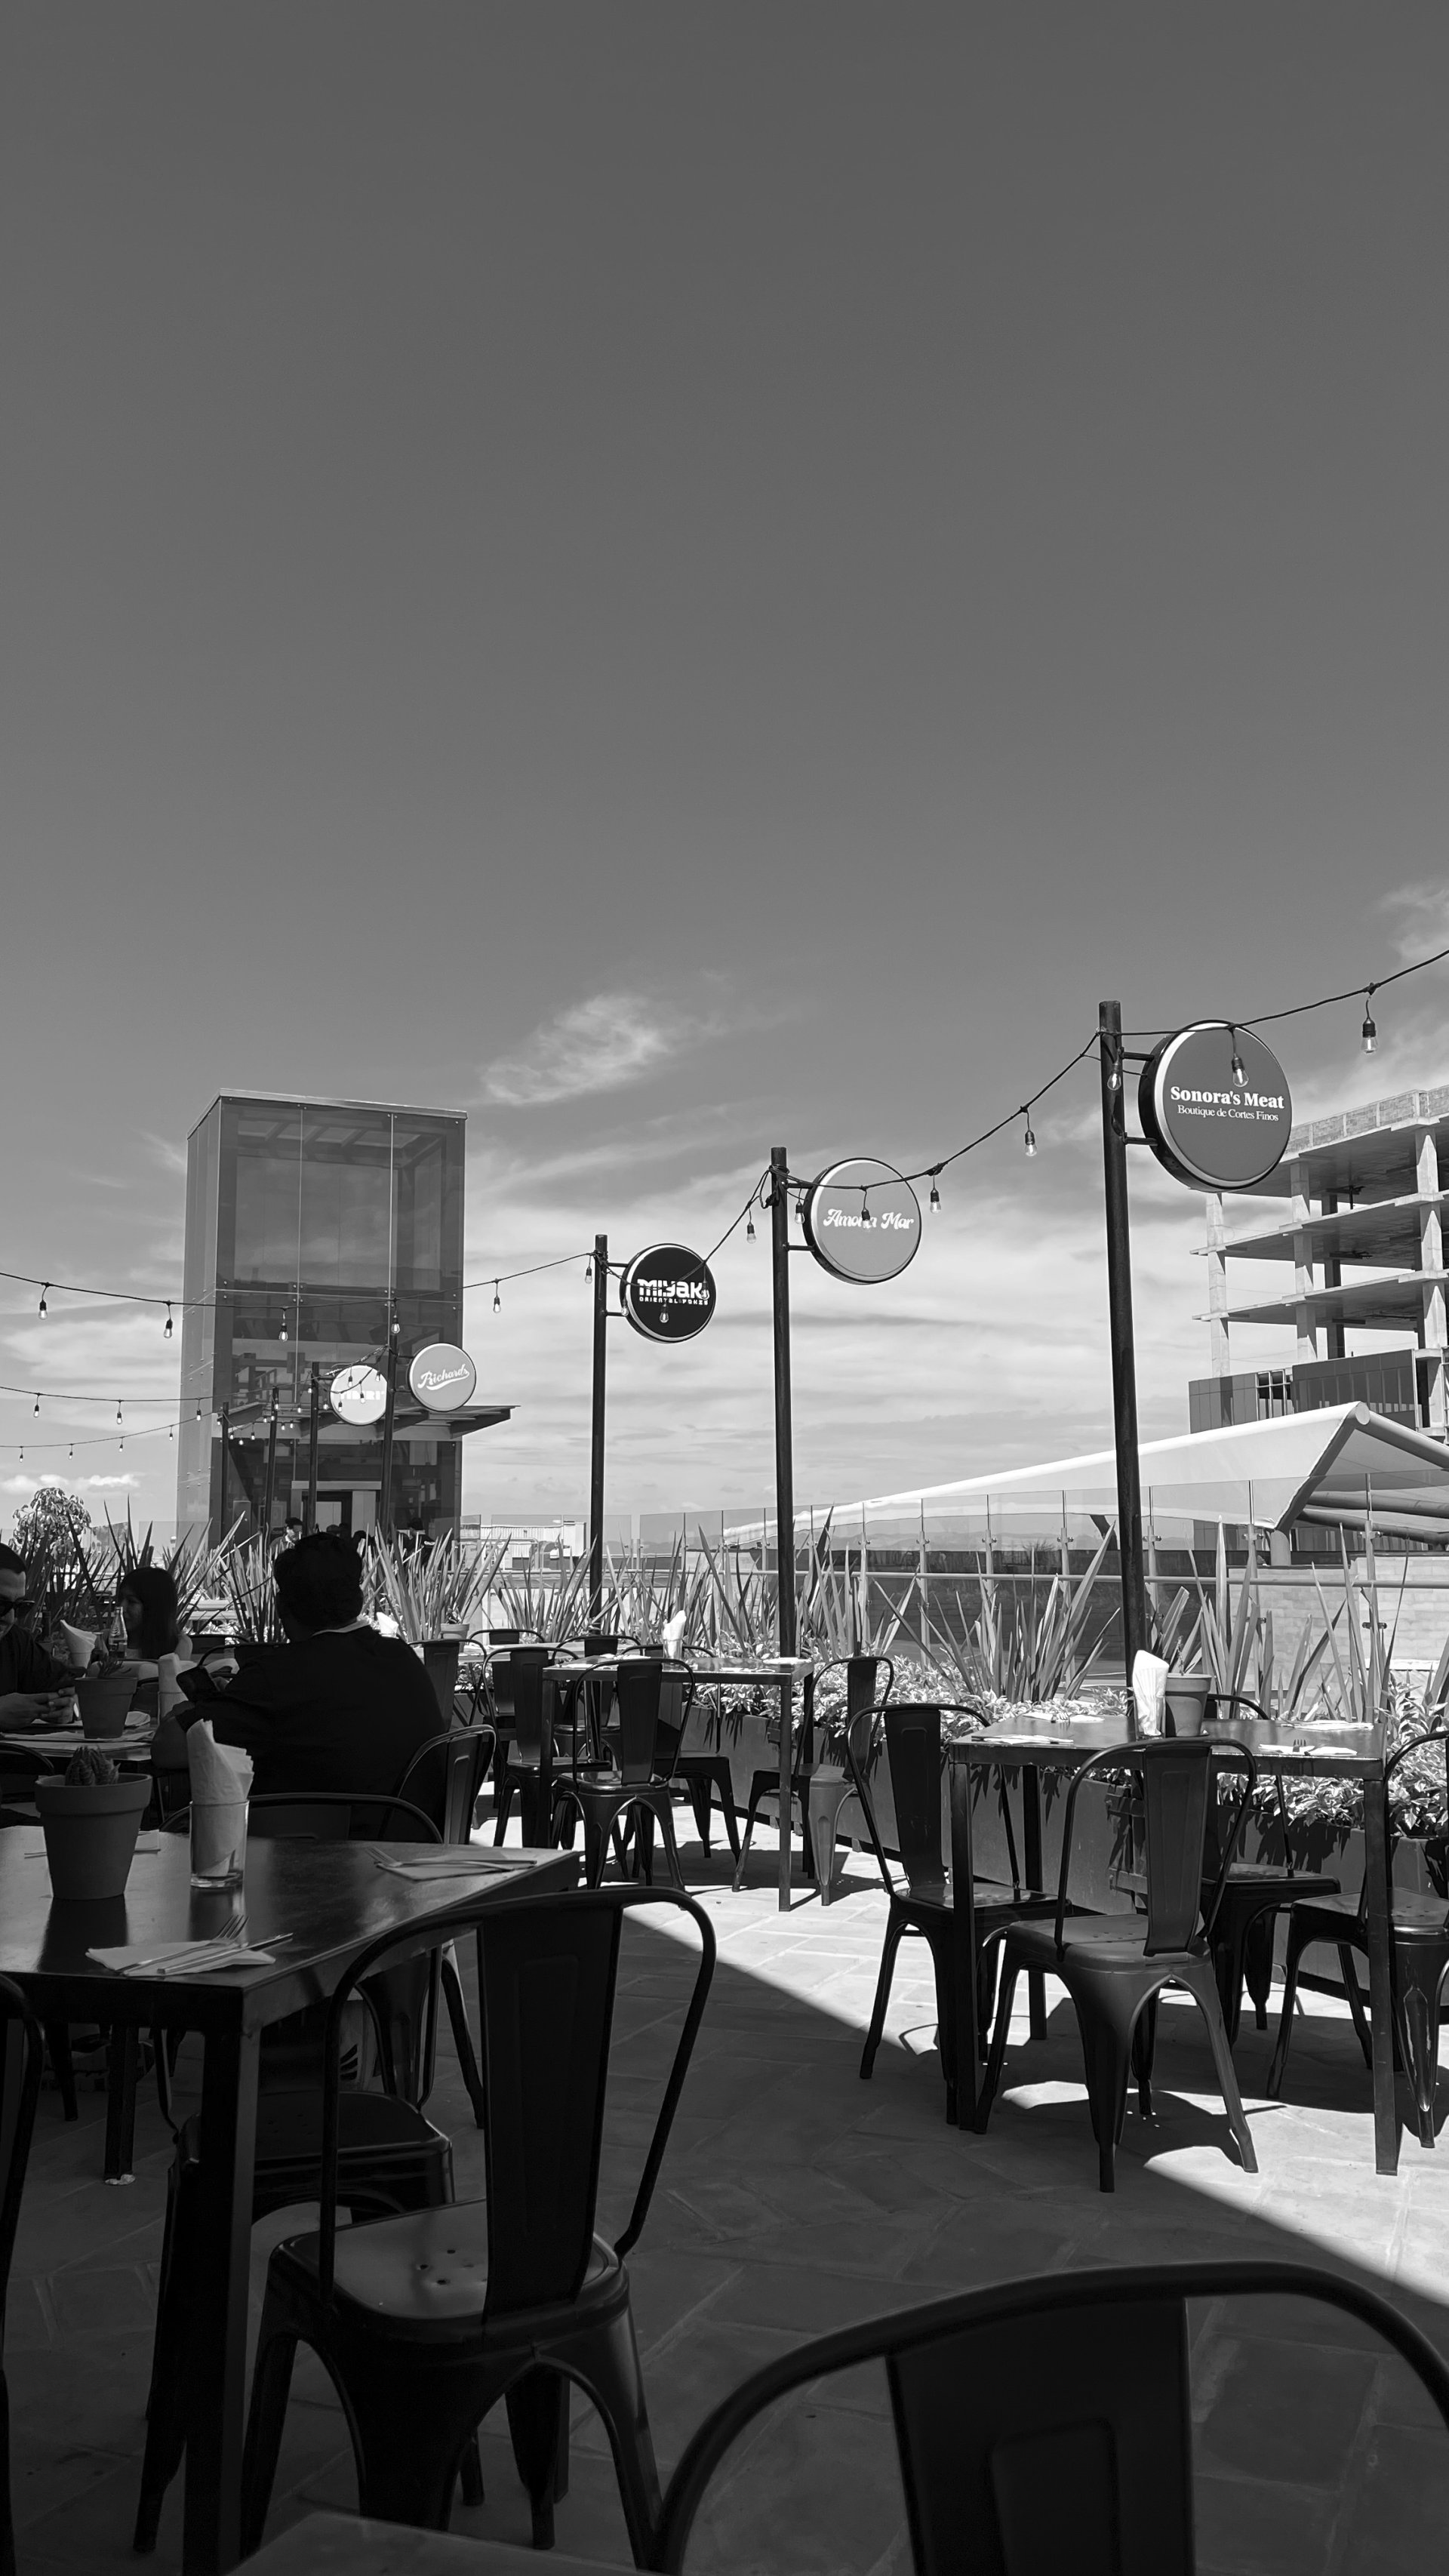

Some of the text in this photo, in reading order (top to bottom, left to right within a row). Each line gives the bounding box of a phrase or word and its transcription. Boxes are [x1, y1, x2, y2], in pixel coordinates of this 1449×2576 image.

[1171, 1085, 1285, 1109] Sonora's Meat
[1177, 1104, 1279, 1121] Boutique de Cortes Finos
[880, 1211, 915, 1230] Mar
[417, 1363, 469, 1389] Richards
